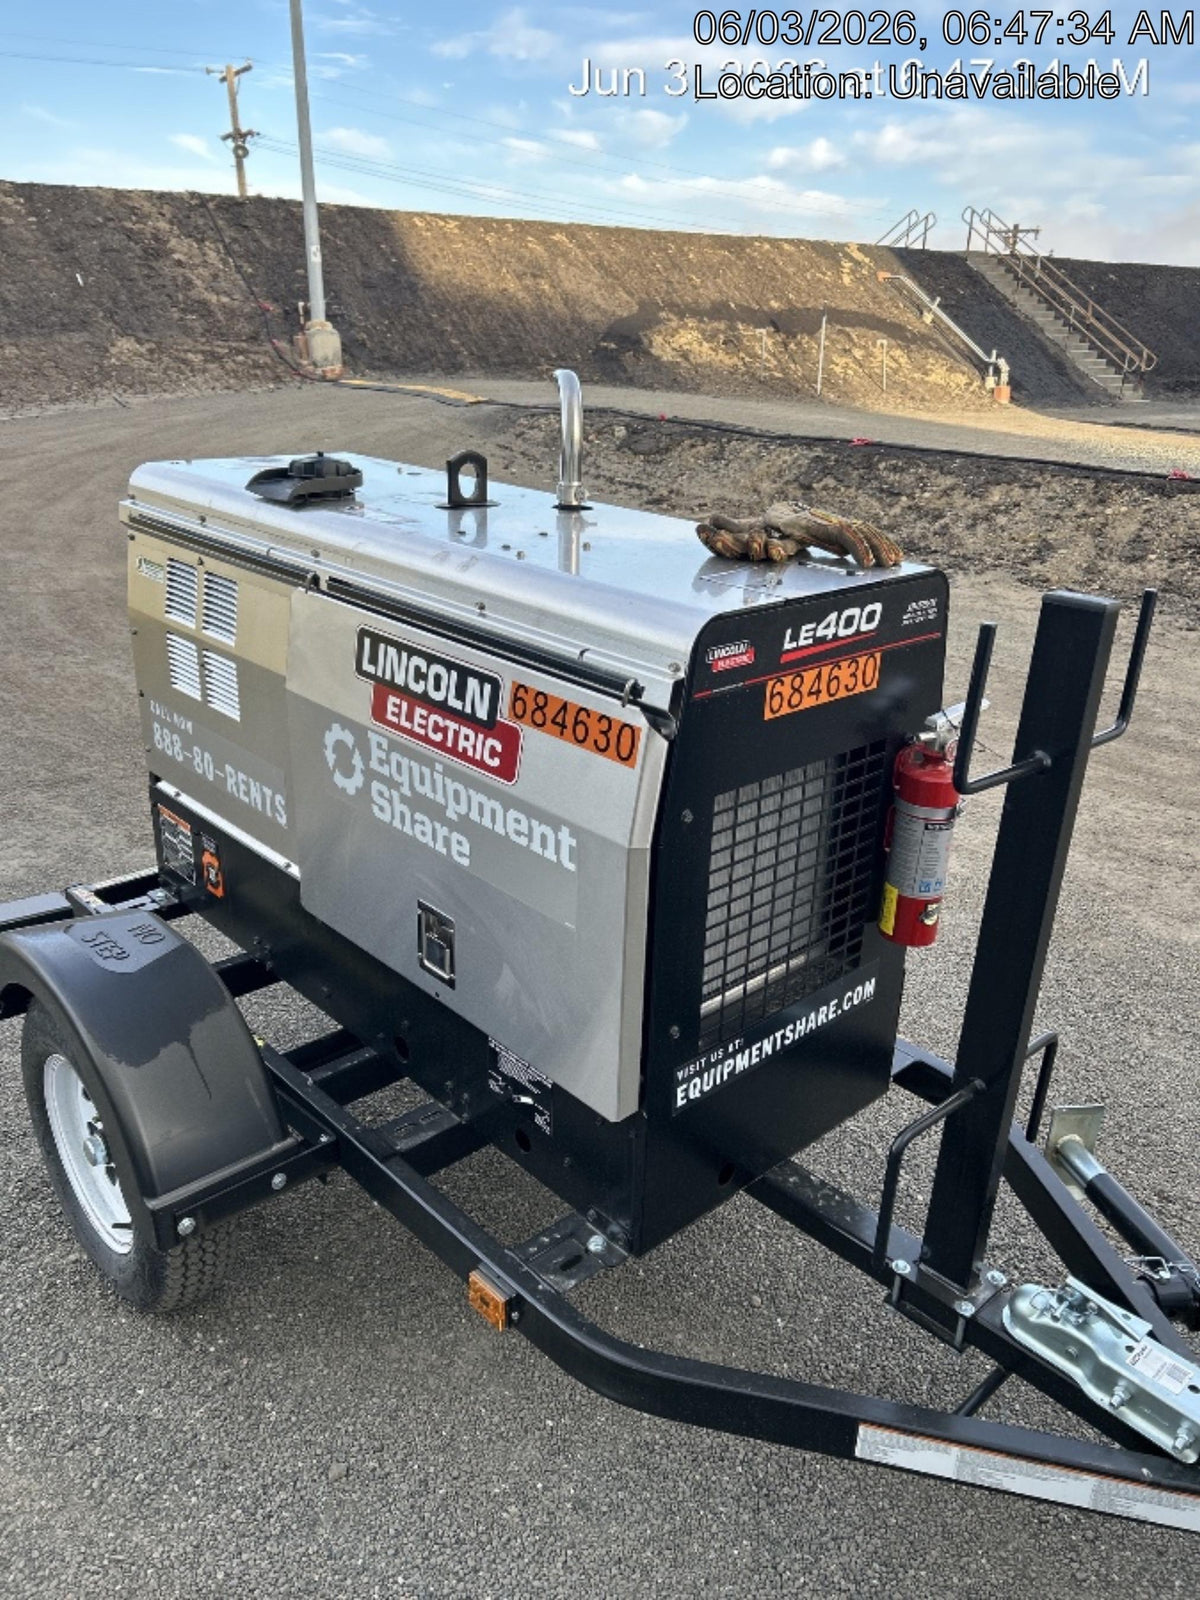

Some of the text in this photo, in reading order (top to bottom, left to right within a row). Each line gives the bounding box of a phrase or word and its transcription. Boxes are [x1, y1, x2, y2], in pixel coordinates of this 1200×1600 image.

[783, 602, 882, 650] LE400
[362, 637, 491, 720] LINCOLN
[769, 654, 877, 714] 684630
[386, 694, 502, 768] ELECTRIC
[512, 684, 635, 761] 684630
[153, 721, 288, 829] 888-80-RENTS
[368, 730, 577, 872] Equipment
[371, 780, 471, 866] Share
[82, 931, 130, 961] STEP
[128, 923, 166, 945] NO
[675, 977, 876, 1108] EQUIPMENTSHARE.COM
[676, 1058, 706, 1081] VISIT
[710, 1048, 724, 1063] US
